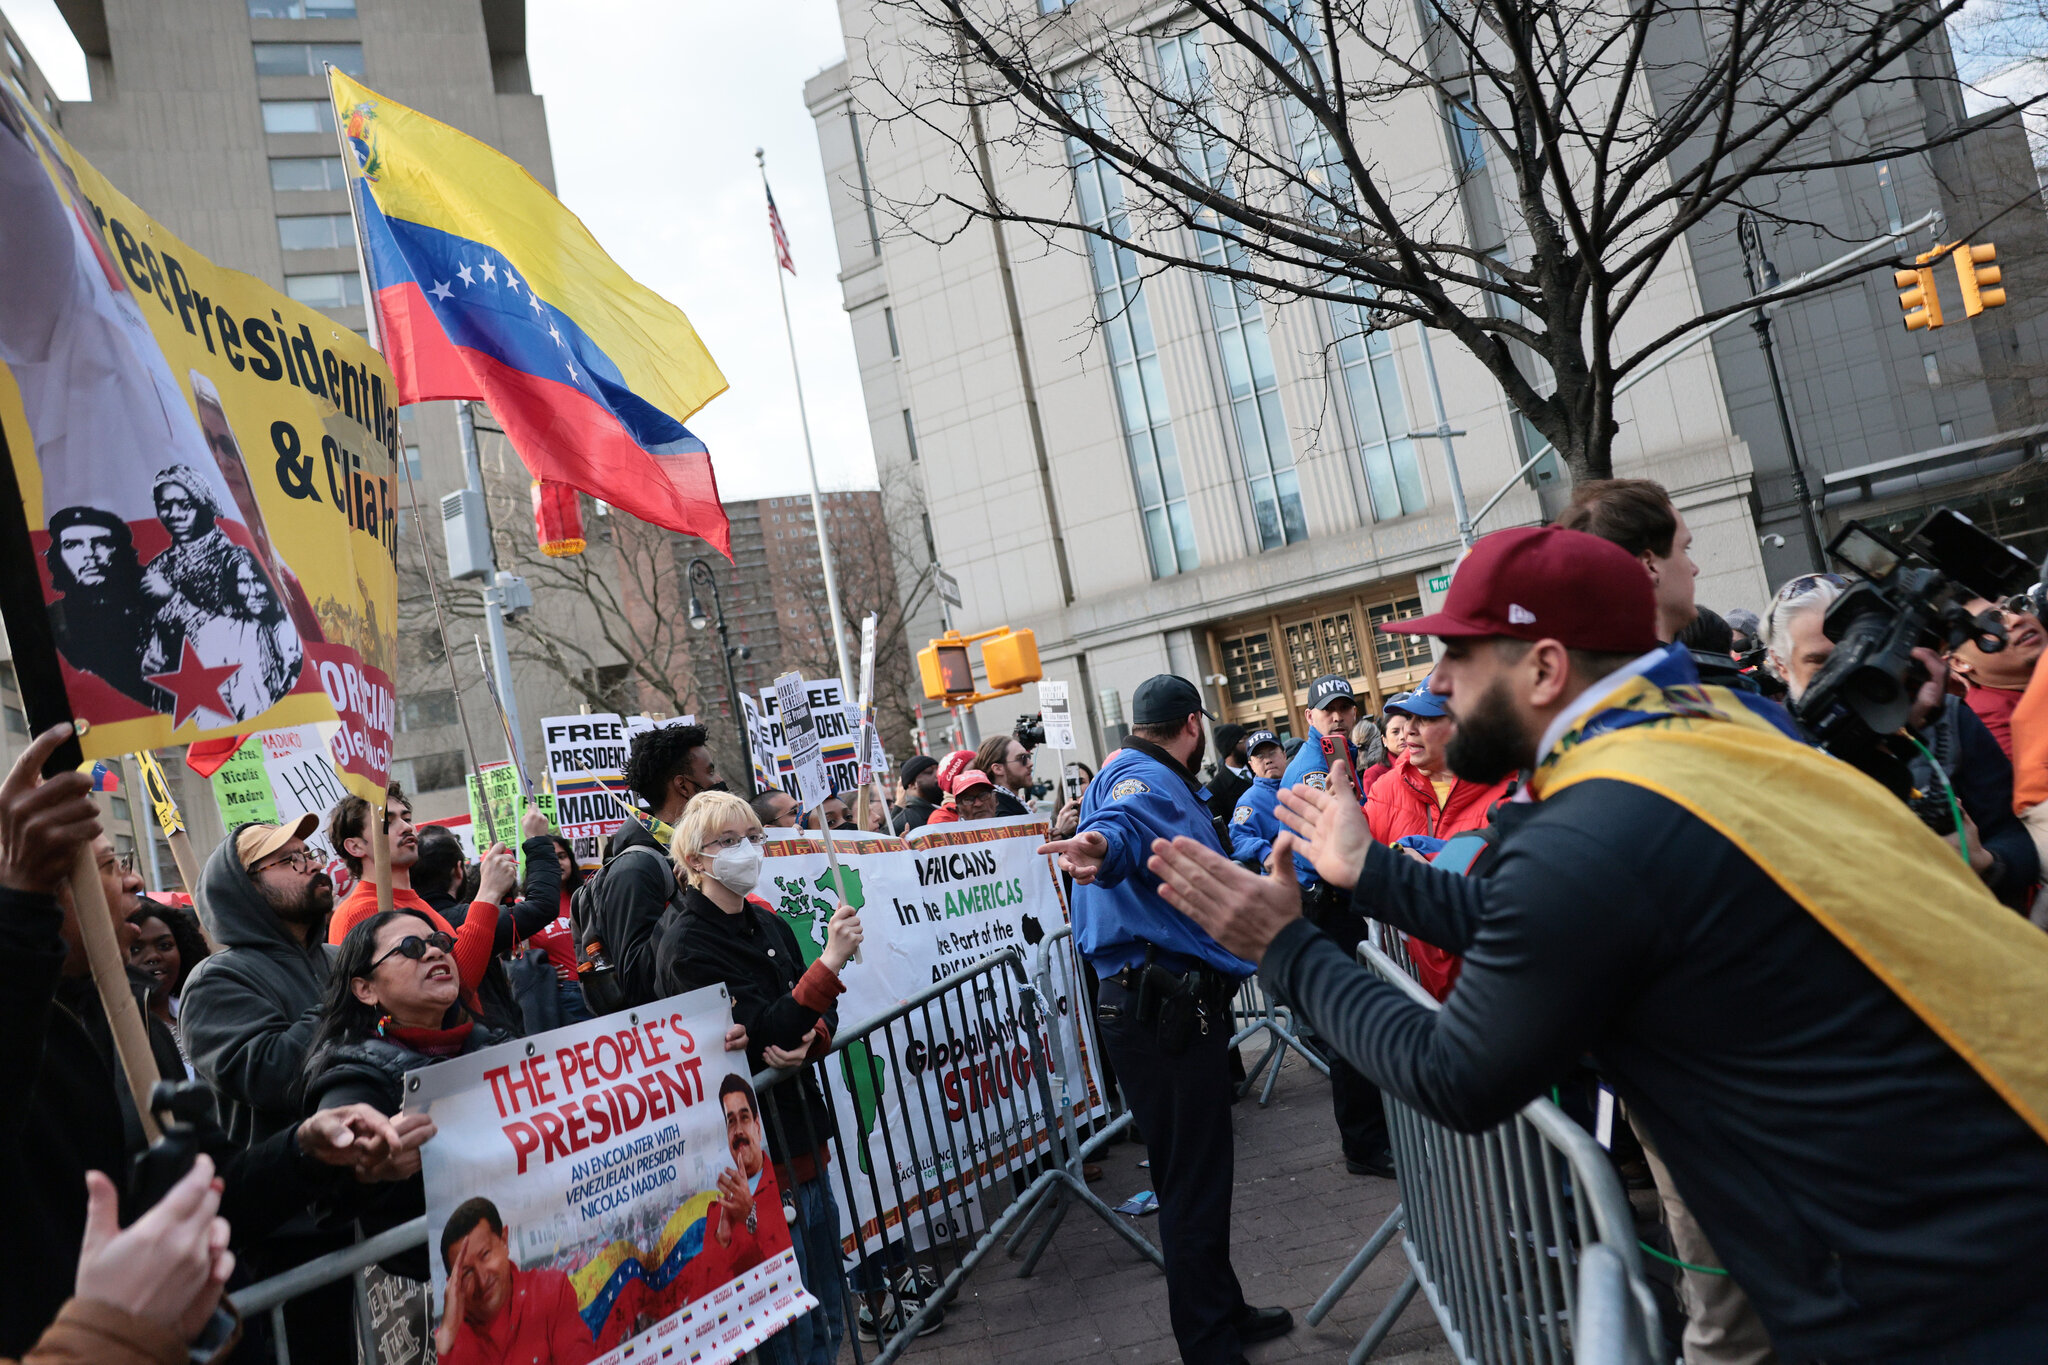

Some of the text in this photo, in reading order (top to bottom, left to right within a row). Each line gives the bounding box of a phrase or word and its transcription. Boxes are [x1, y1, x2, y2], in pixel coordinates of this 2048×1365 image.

[161, 252, 371, 432] President
[270, 420, 323, 503] &
[765, 688, 841, 716] FEE
[1317, 679, 1350, 697] NYPD
[547, 723, 622, 744] FREE
[1249, 732, 1273, 747] NYPD
[551, 746, 626, 773] PRESIDENT
[946, 758, 963, 781] CANADA
[225, 790, 265, 806] Maduro
[523, 796, 553, 810] FEE
[893, 897, 920, 926] In
[945, 878, 1023, 919] AMERICAS
[949, 929, 979, 952] Part
[981, 922, 992, 945] of
[993, 920, 1013, 941] the
[483, 1013, 696, 1119] THE PEOPLE'S
[502, 1056, 705, 1176] PRESIDENT
[571, 1123, 681, 1184] AN ENCOUNTER WITH
[566, 1140, 686, 1206] VENEZUELAN PRESIDENT
[581, 1164, 677, 1222] NICOLAS MADURO
